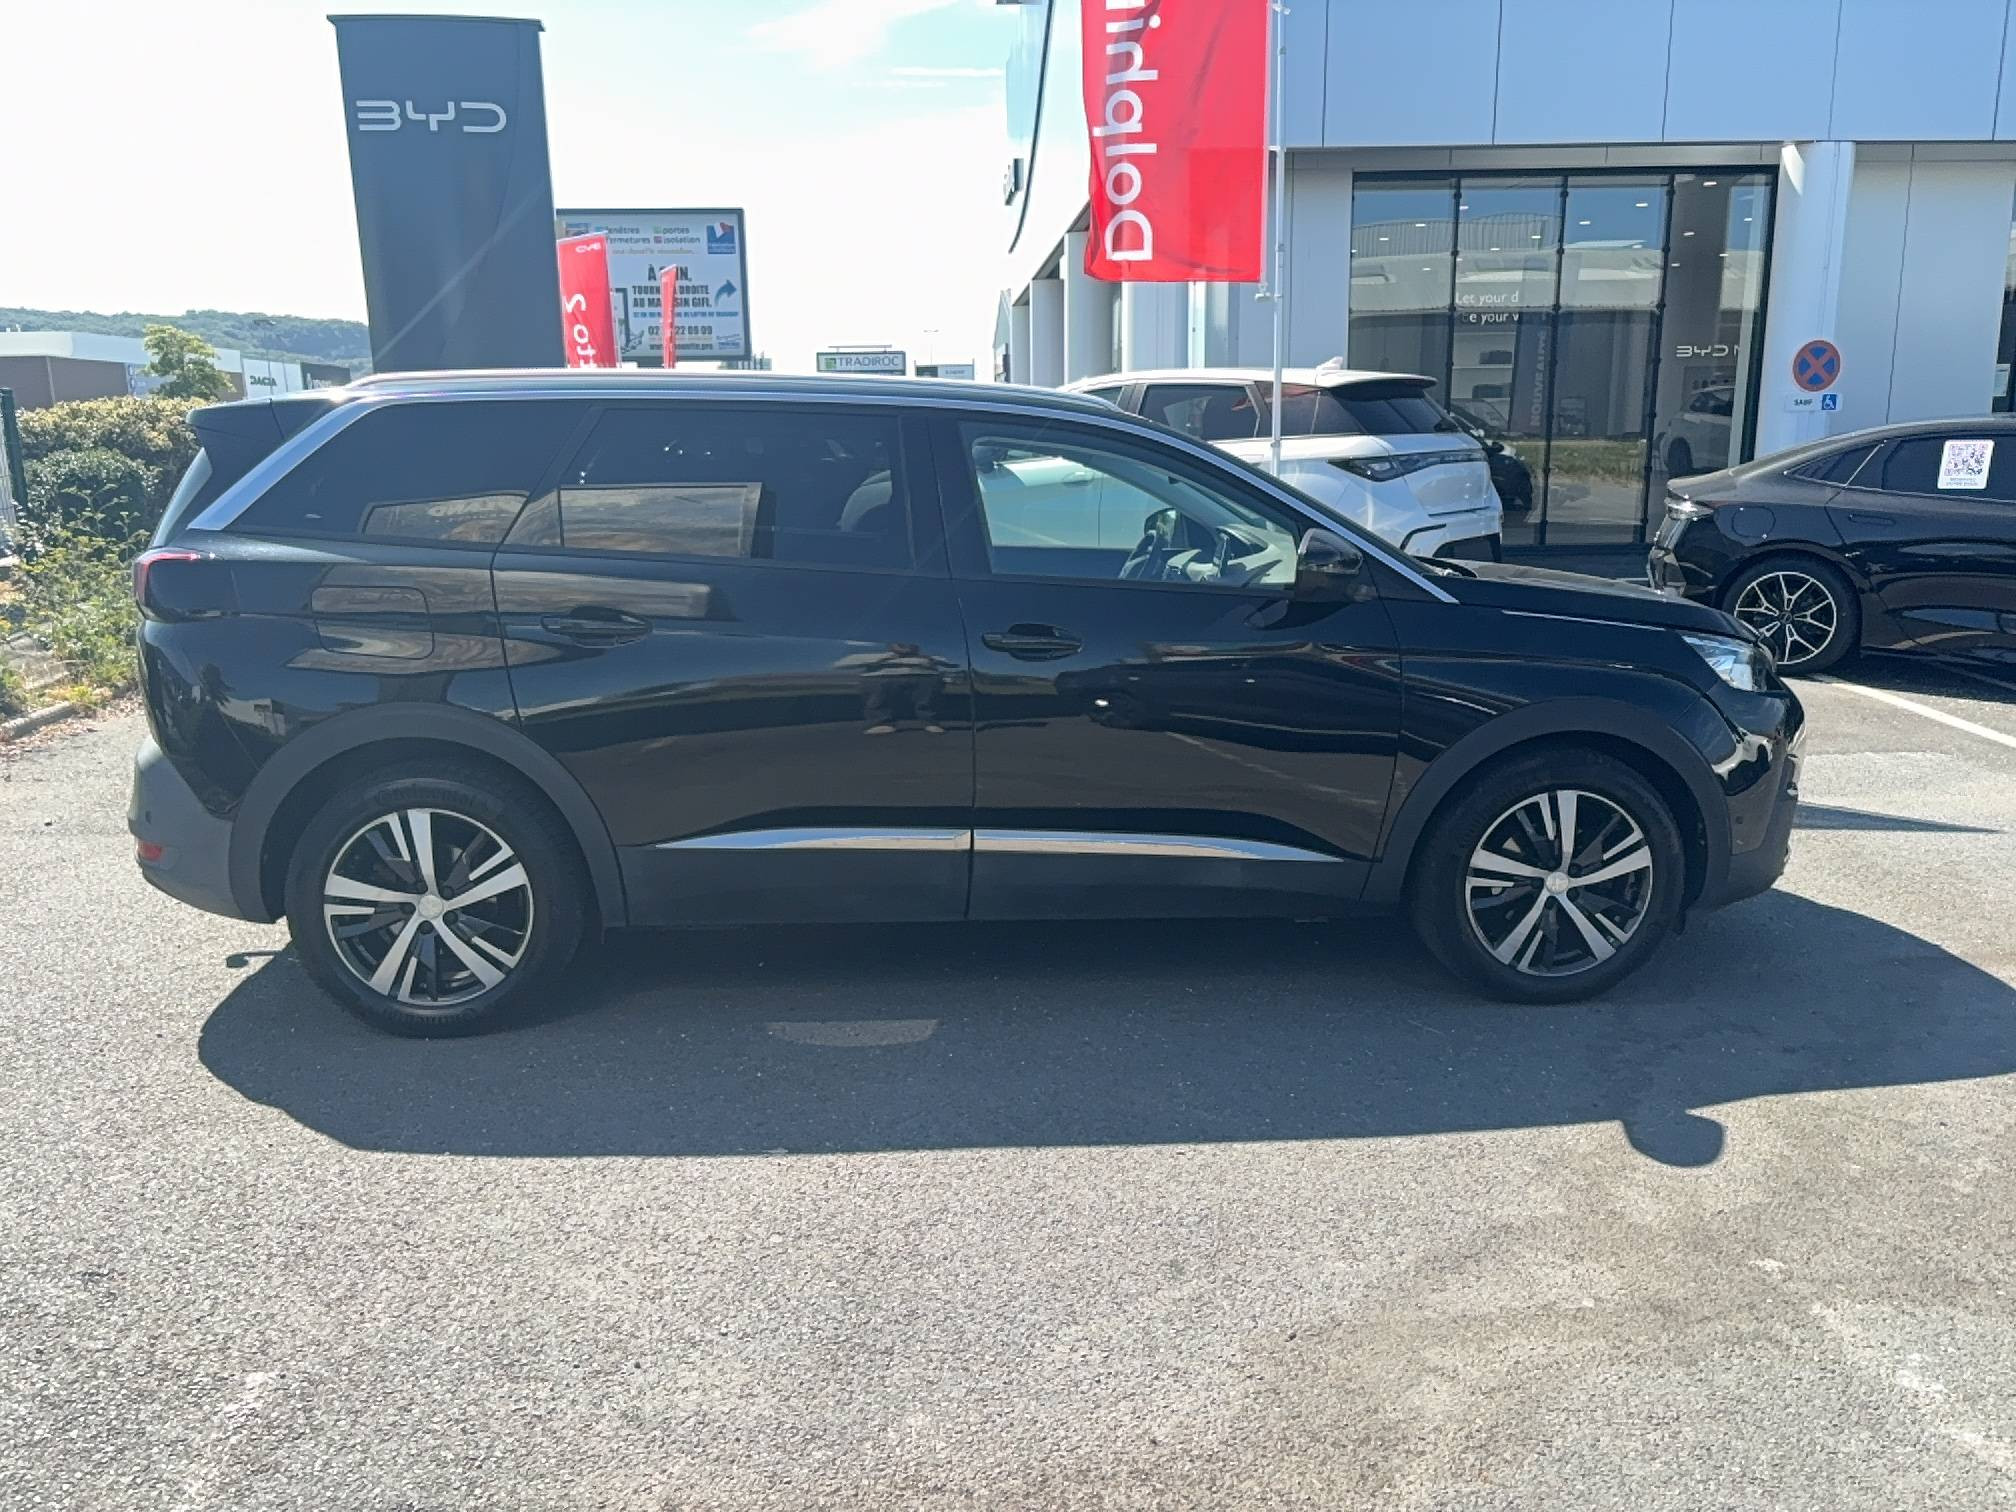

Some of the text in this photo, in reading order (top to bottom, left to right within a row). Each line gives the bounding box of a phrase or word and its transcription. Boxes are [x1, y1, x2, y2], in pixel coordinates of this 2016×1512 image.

[355, 100, 507, 133] BYD
[632, 285, 661, 294] TOURN
[679, 285, 710, 294] DROITE
[1480, 294, 1507, 306] your
[1481, 313, 1509, 325] your
[1676, 344, 1729, 358] BYD
[838, 355, 899, 367] TRADIROC
[249, 375, 277, 387] DACIA
